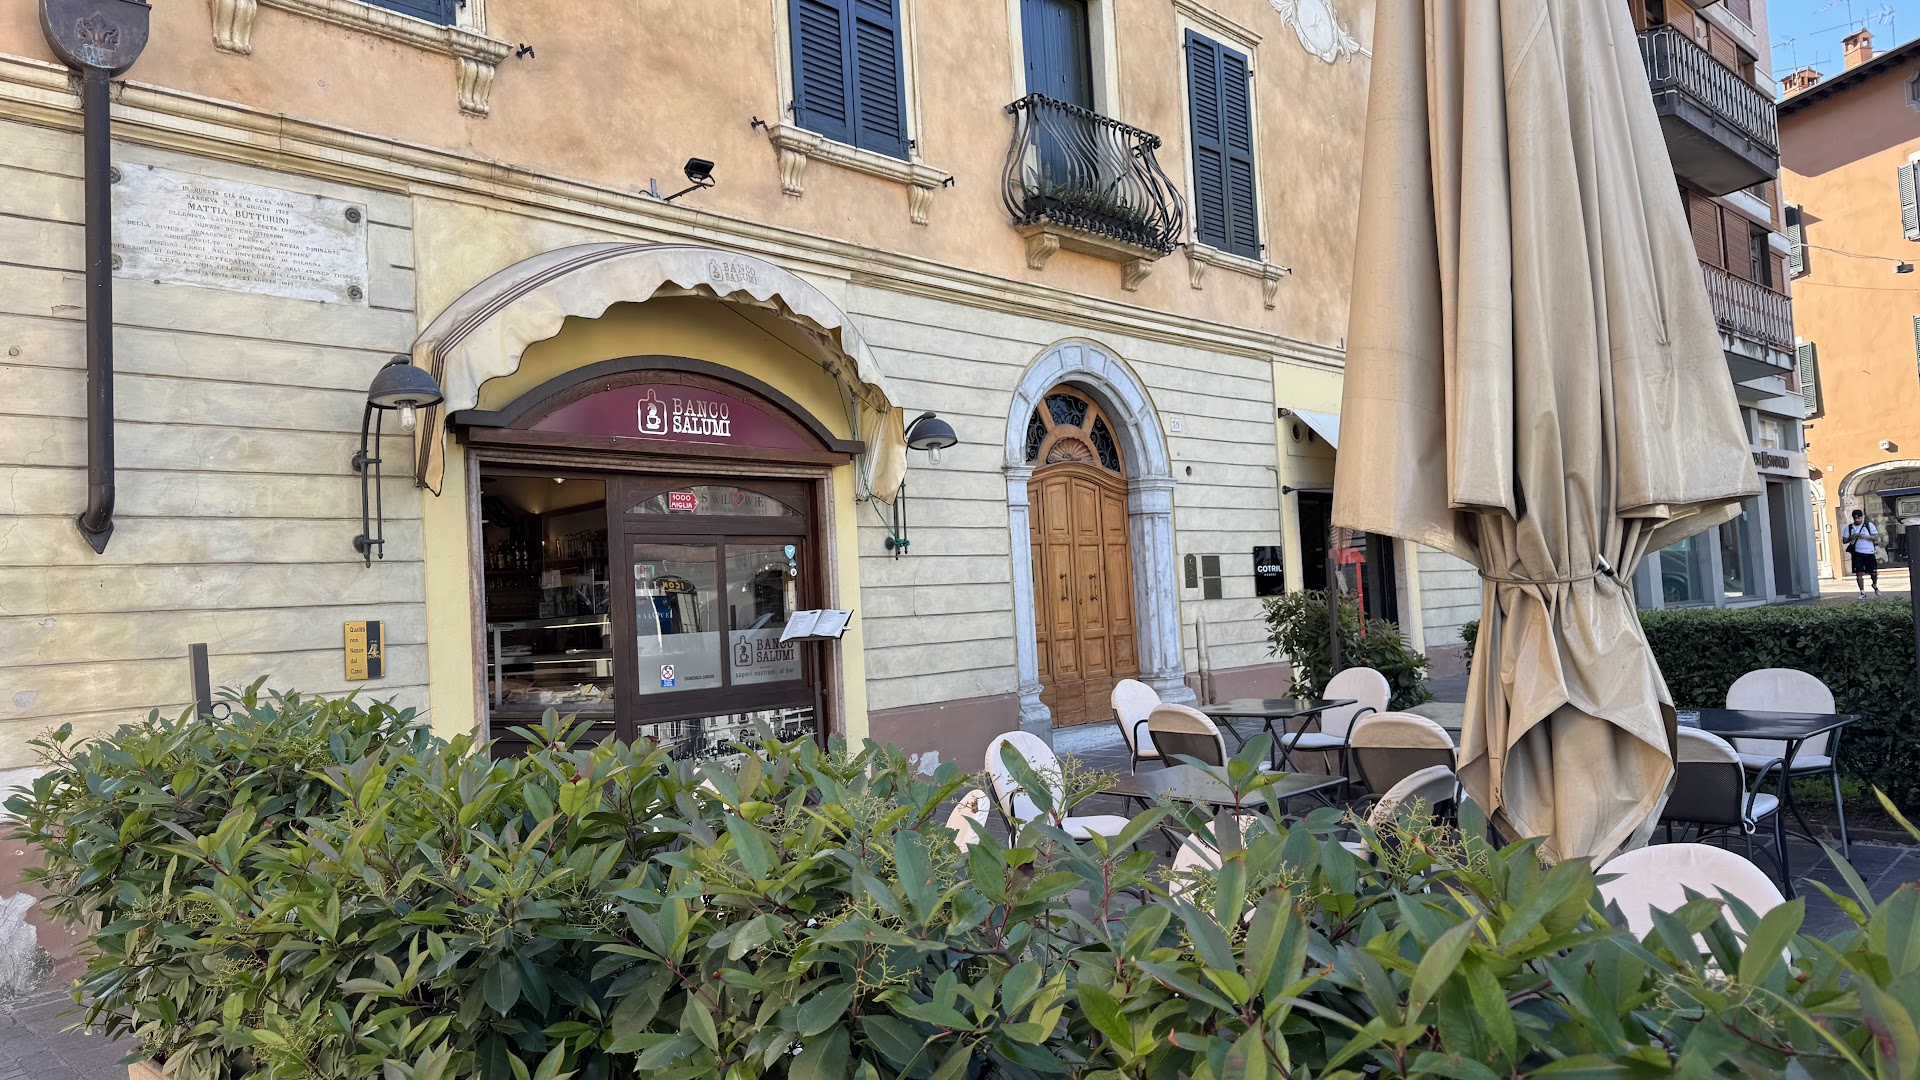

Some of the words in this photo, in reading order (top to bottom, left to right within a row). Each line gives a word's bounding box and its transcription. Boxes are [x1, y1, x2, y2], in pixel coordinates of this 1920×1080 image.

[186, 194, 218, 203] NASCEVA
[195, 188, 219, 196] QUESTA
[188, 203, 227, 215] MATTIA
[236, 210, 288, 225] BUTTURINI
[282, 227, 306, 235] INSIGNE
[271, 241, 300, 250] VENEZIA
[723, 262, 756, 276] BANCO
[725, 272, 758, 285] SALUMI
[672, 398, 728, 419] BANCO
[673, 416, 731, 436] SALUMI
[756, 638, 793, 650] BANCO
[756, 649, 794, 662] SALUMI
